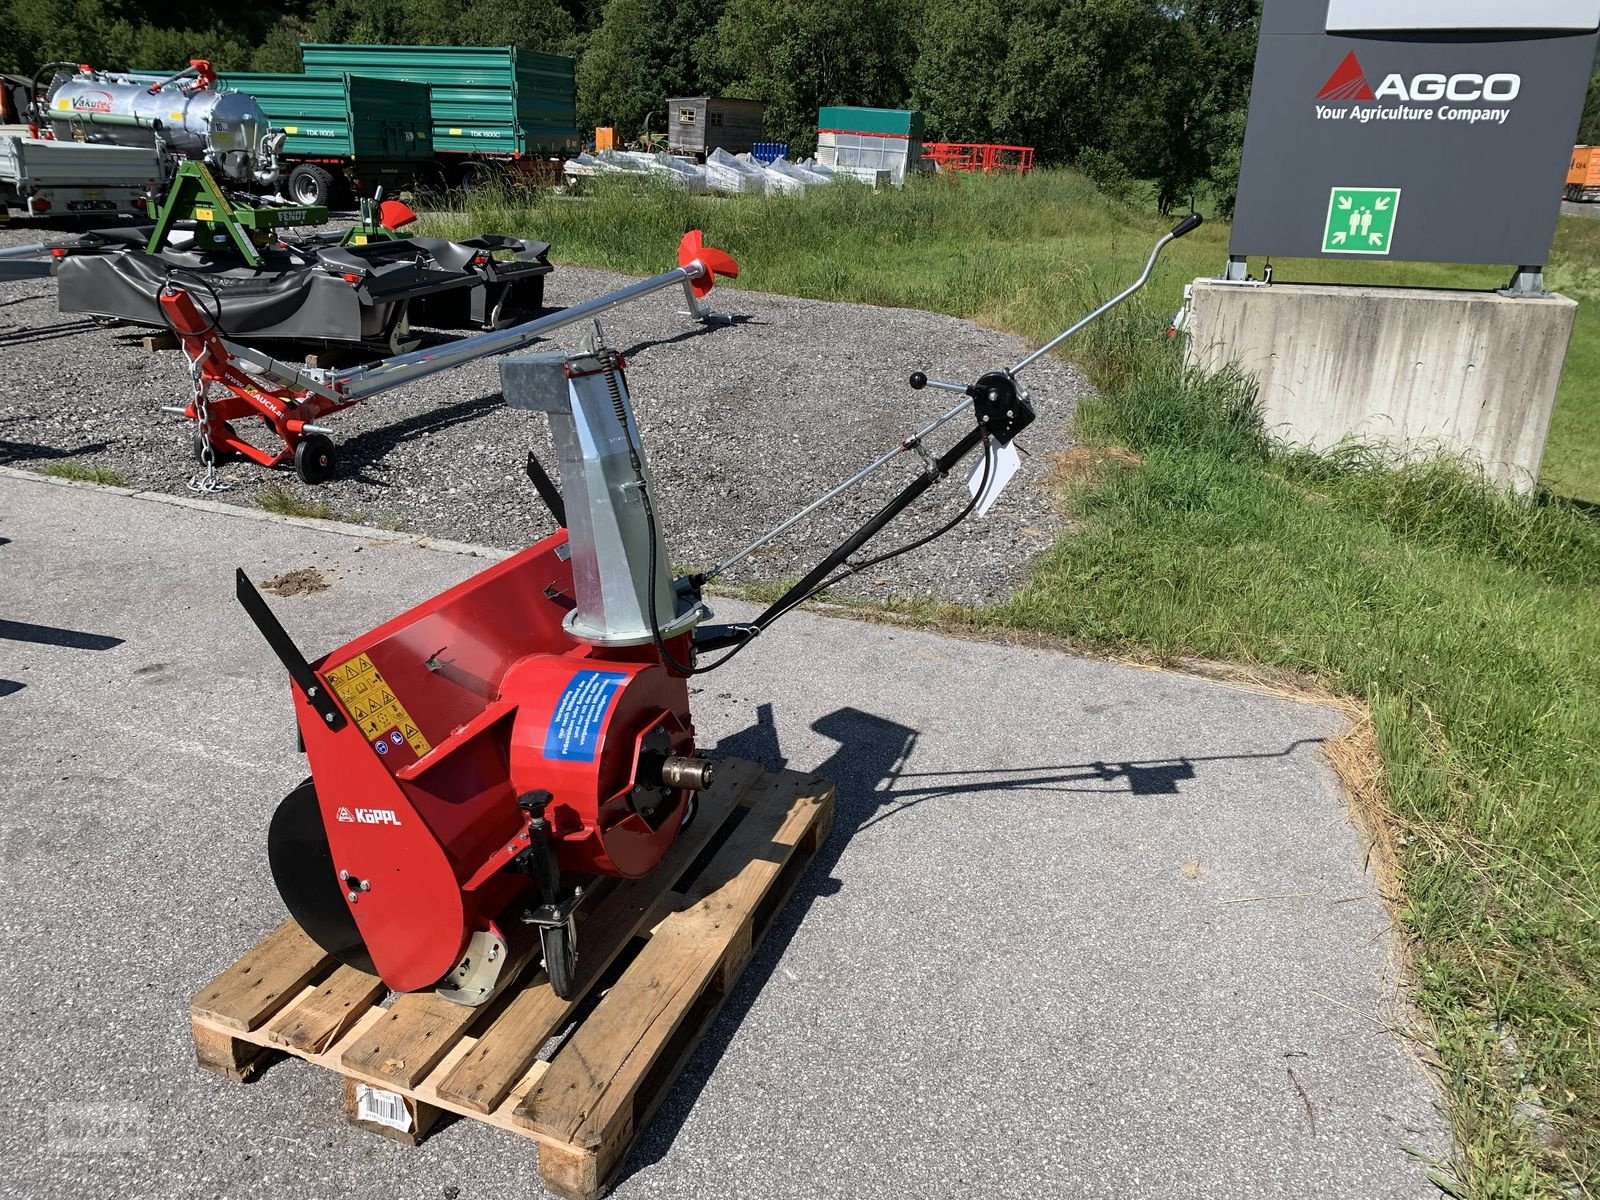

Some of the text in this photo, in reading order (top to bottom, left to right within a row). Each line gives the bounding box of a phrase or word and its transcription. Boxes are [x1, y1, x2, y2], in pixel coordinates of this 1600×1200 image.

[1374, 73, 1521, 101] AGCO
[72, 95, 112, 108] Vakutec
[1315, 105, 1511, 124] Your Agriculture Company
[305, 129, 318, 137] TDK
[278, 210, 308, 221] FENDT
